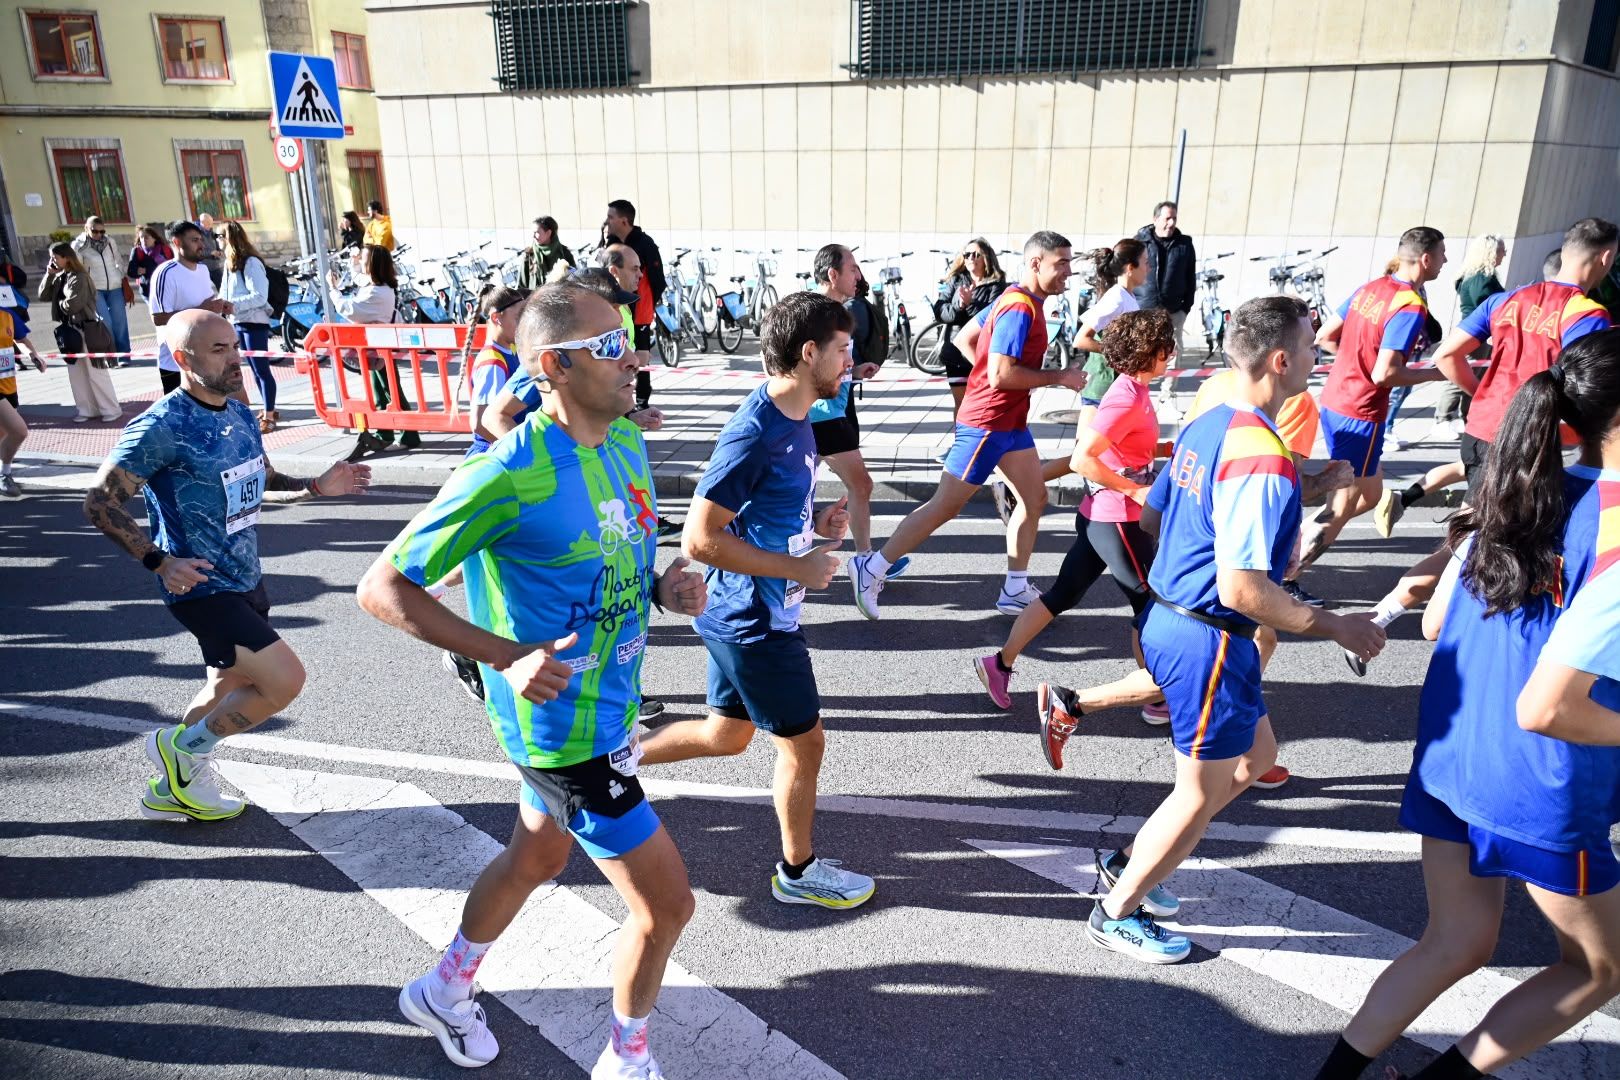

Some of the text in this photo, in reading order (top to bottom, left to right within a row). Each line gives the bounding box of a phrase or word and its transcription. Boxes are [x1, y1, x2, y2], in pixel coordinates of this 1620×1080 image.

[280, 145, 295, 158] 30
[1495, 300, 1561, 340] ABA
[1169, 443, 1206, 506] ABA
[240, 477, 259, 505] 497
[1113, 926, 1144, 948] HOKA
